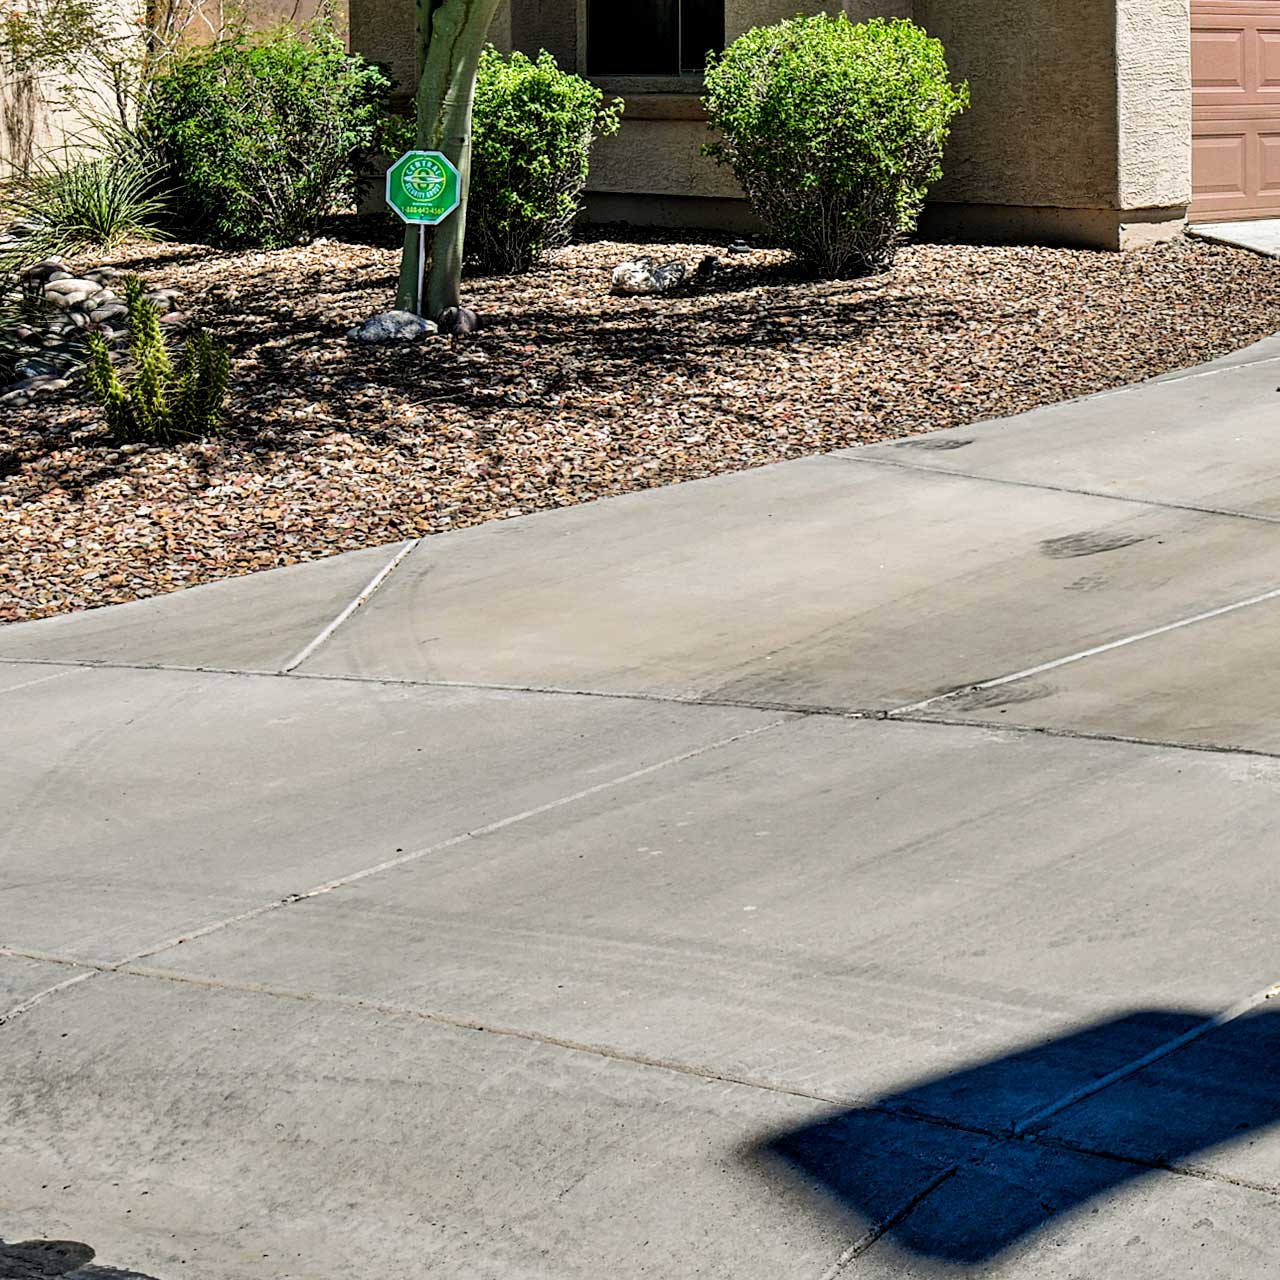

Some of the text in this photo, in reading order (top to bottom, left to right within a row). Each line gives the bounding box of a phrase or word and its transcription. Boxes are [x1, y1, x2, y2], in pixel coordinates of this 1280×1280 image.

[406, 160, 441, 175] CENTRAL
[405, 183, 442, 199] SECURITY GROUP
